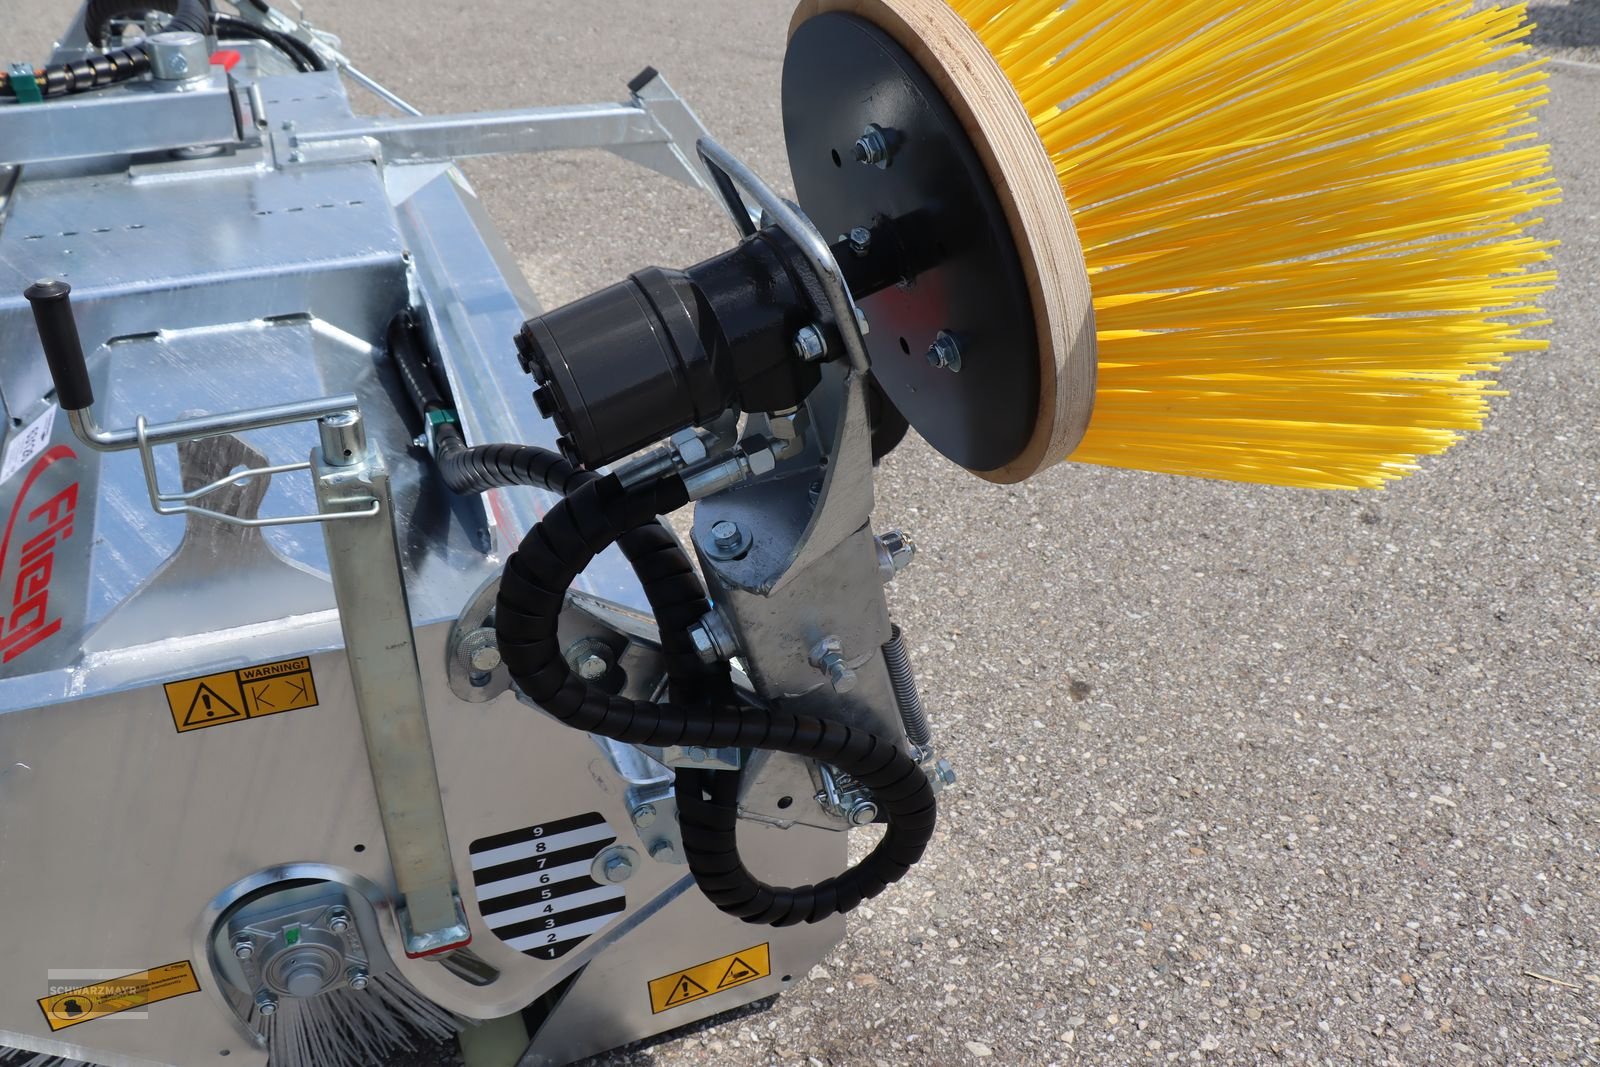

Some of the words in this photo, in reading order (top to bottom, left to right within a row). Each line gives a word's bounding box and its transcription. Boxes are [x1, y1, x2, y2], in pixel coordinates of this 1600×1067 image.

[0, 481, 79, 664] Fliegl
[243, 660, 305, 679] WARNING!
[533, 827, 544, 837] 9
[535, 842, 546, 852] 8
[537, 858, 547, 869] 7
[539, 873, 550, 884] 6
[541, 889, 551, 899] 5
[543, 904, 554, 913] 4
[545, 919, 555, 928] 3
[547, 933, 557, 943] 2
[548, 948, 555, 957] 1
